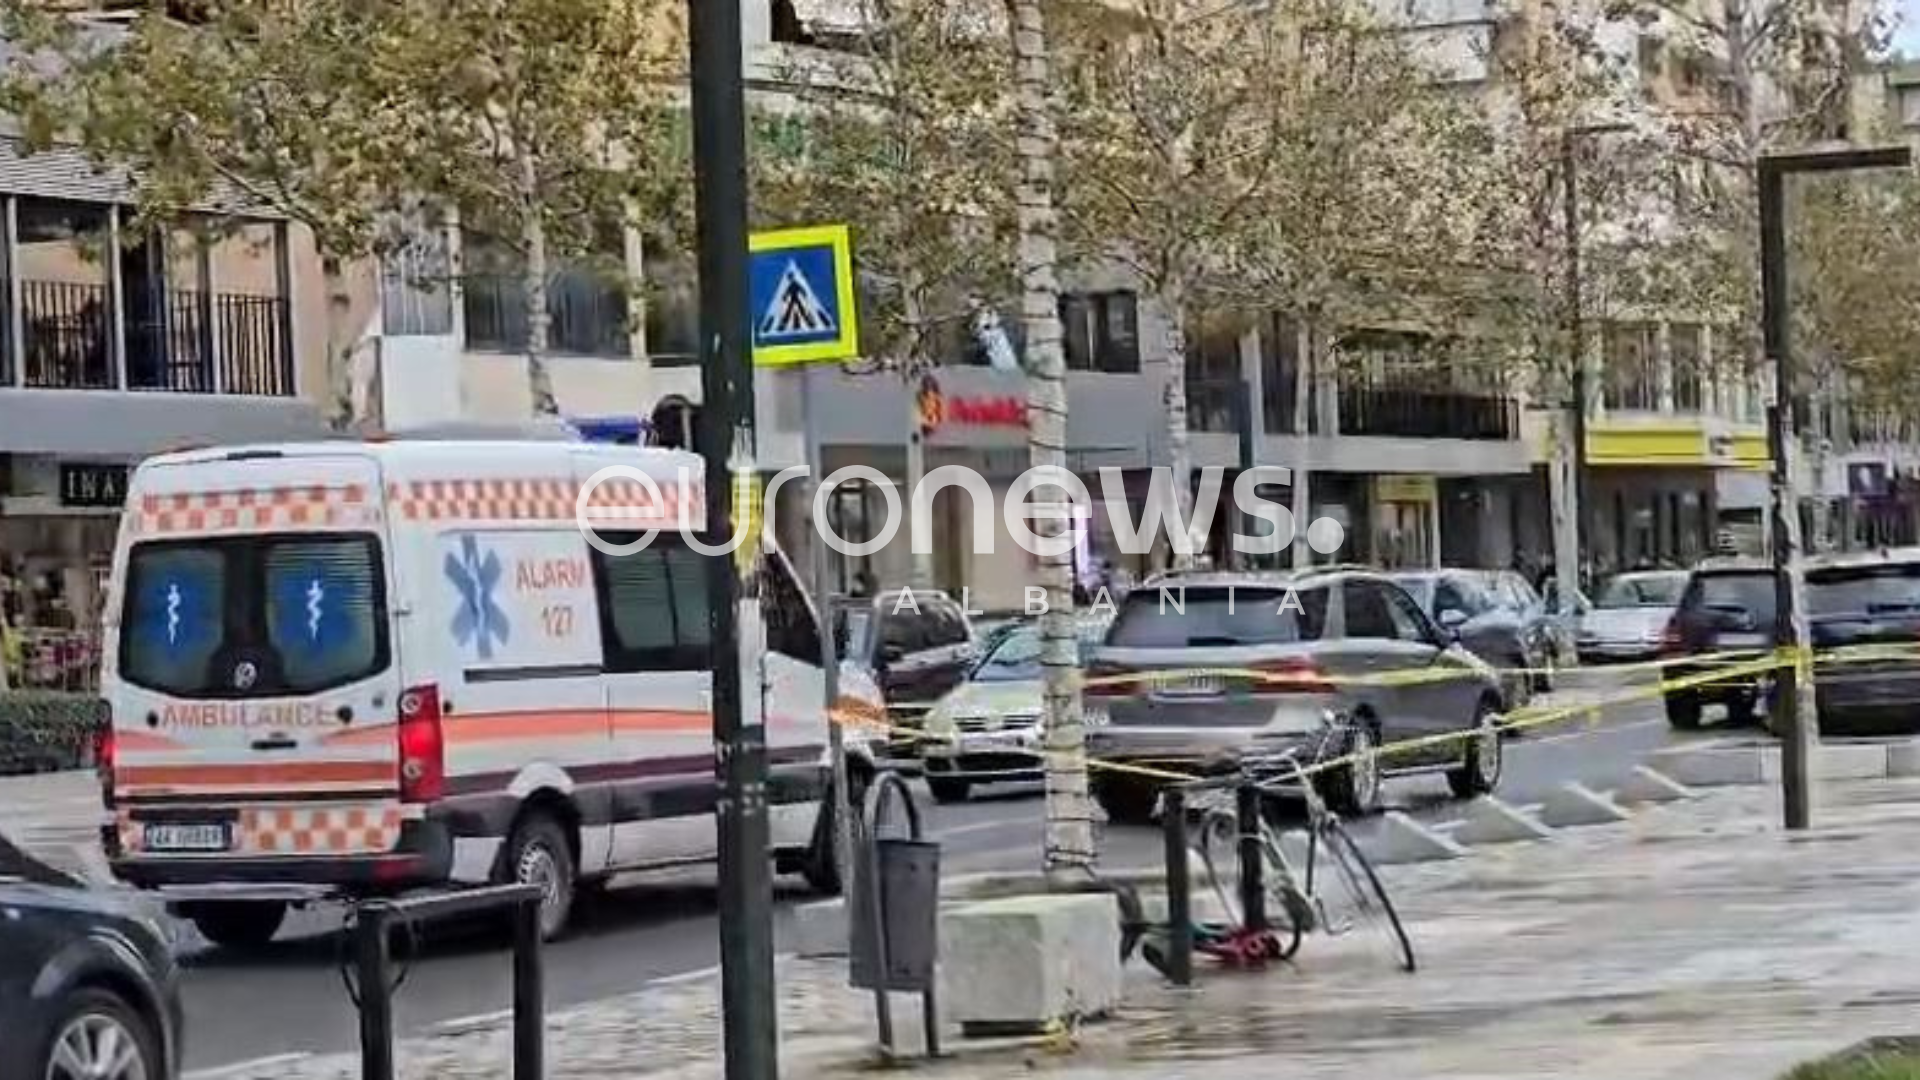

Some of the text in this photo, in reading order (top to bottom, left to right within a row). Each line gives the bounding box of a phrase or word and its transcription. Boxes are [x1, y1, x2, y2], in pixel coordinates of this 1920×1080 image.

[516, 557, 585, 591] ALARM
[542, 605, 573, 637] 127
[163, 702, 338, 729] AMBULANCE
